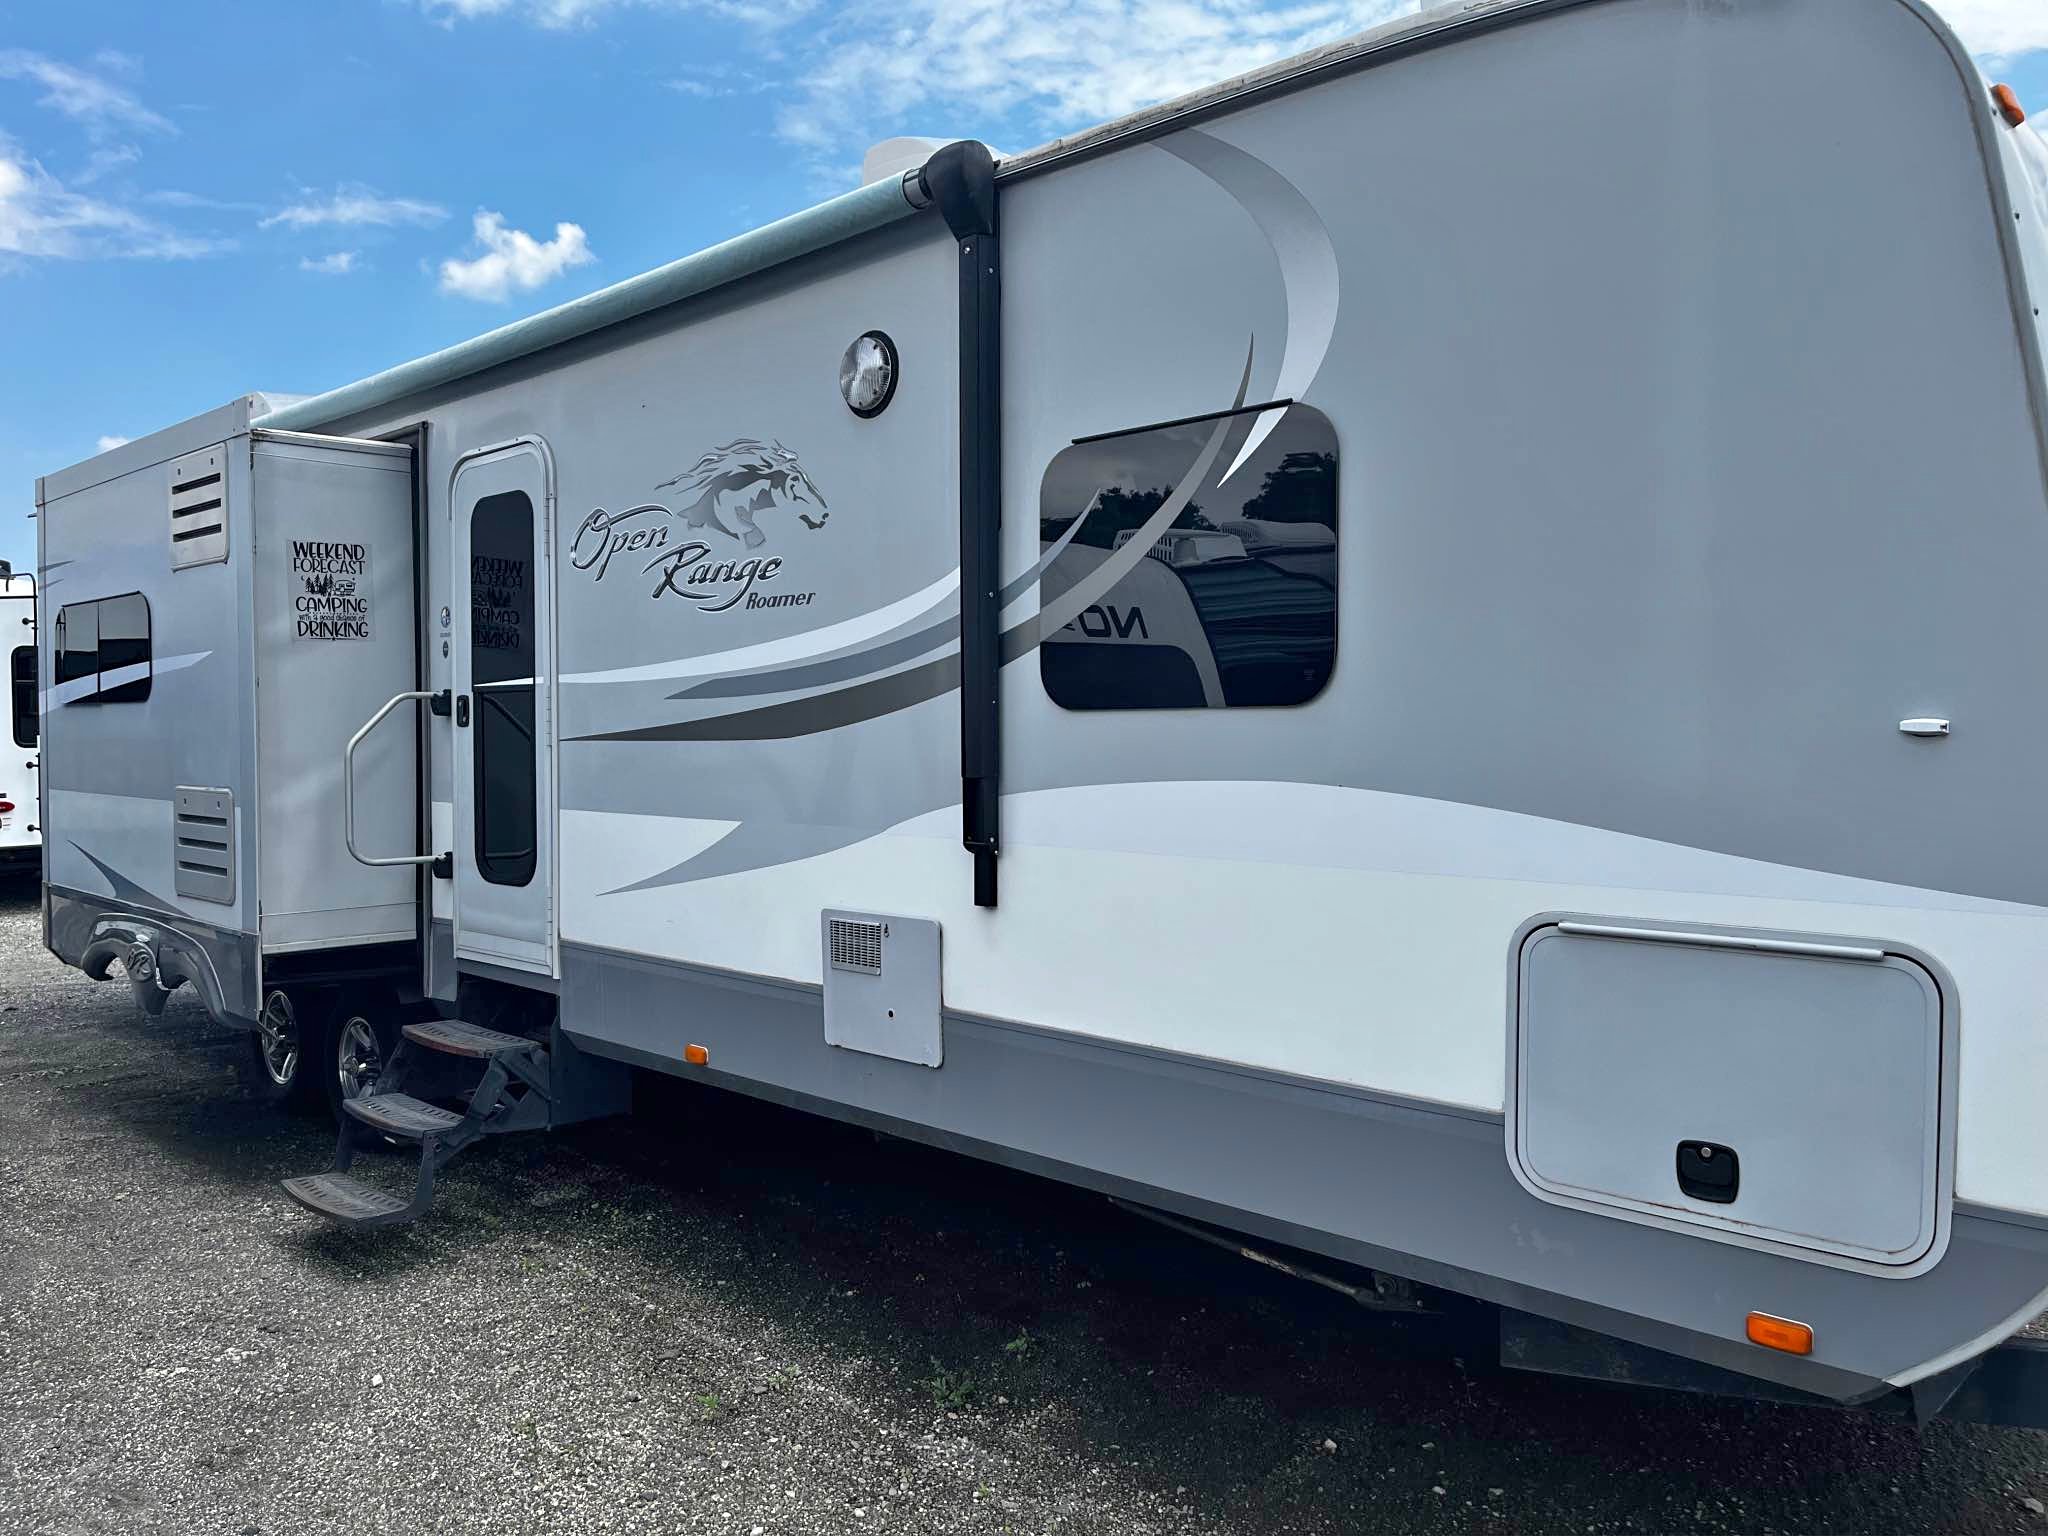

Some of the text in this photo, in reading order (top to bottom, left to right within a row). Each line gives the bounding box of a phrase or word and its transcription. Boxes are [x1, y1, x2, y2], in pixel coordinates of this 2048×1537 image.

[293, 541, 365, 560] WEEKEND
[570, 504, 674, 582] Open
[293, 558, 366, 575] FORECAST
[640, 539, 784, 613] Range
[295, 597, 368, 613] CAMPING
[745, 591, 817, 610] Roamer
[297, 621, 369, 638] DRINKING
